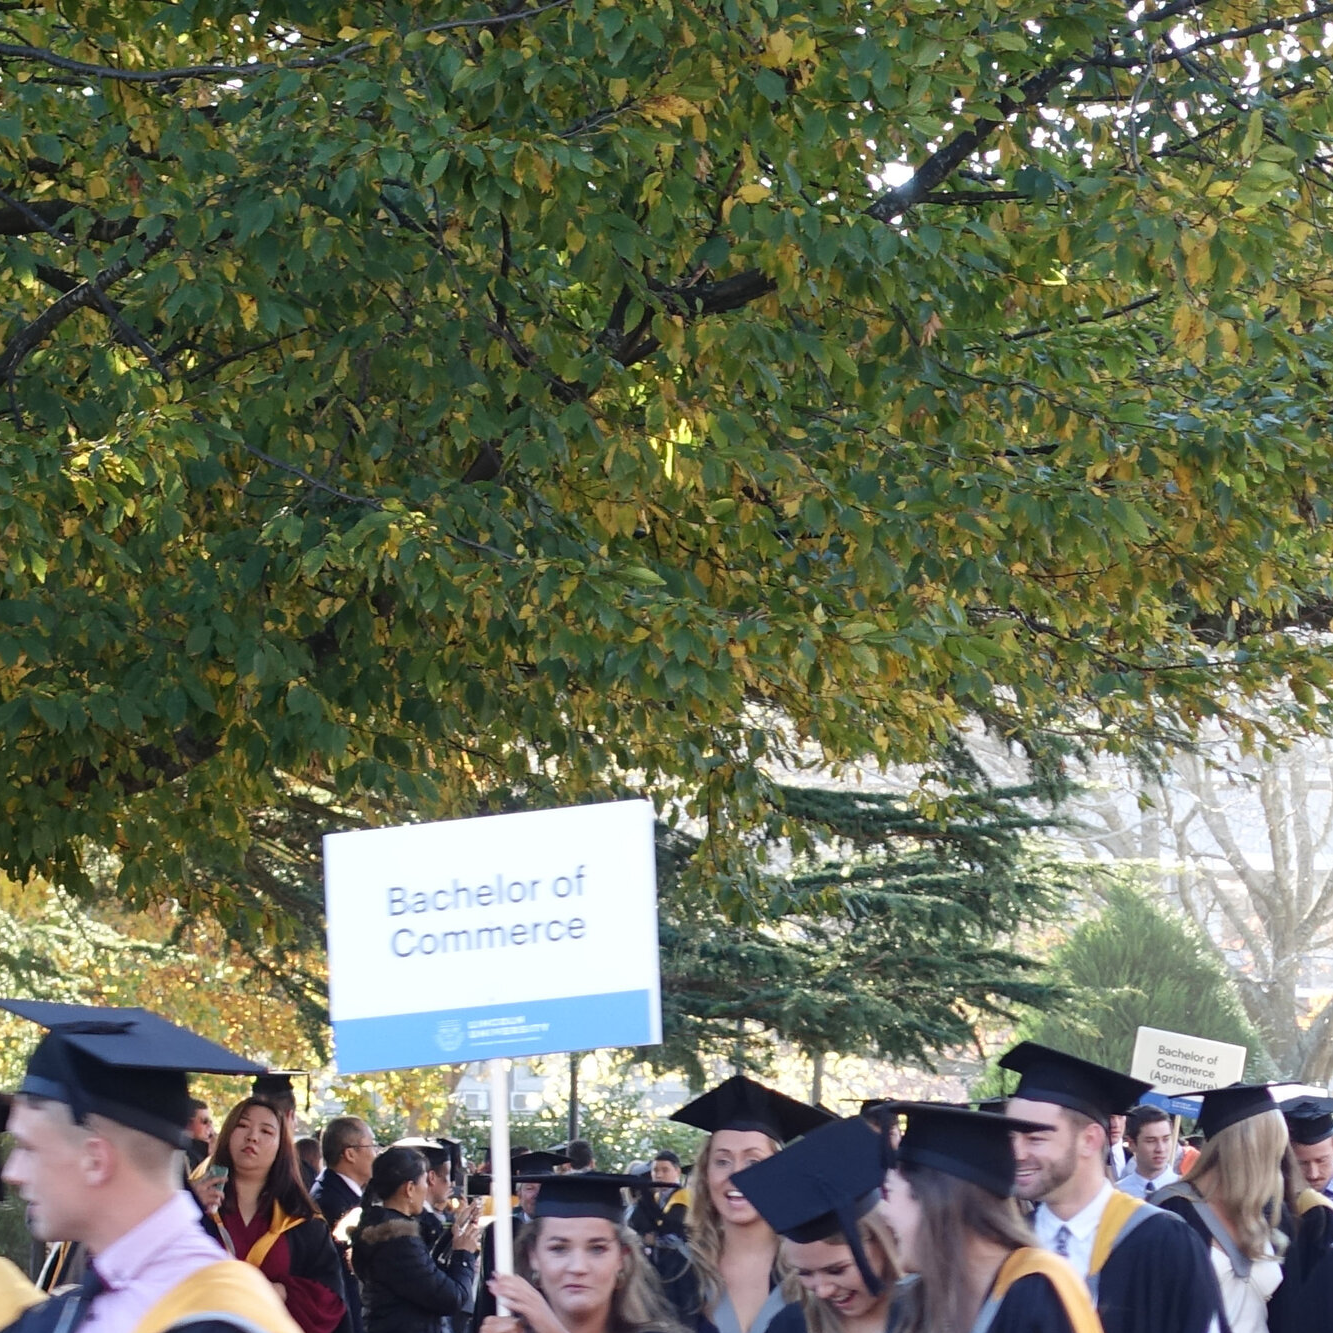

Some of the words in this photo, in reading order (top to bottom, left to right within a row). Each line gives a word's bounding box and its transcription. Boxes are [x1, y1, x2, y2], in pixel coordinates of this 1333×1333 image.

[388, 873, 541, 917] Bachelor
[552, 864, 586, 898] of
[391, 917, 586, 958] Commerce
[1156, 1057, 1216, 1079] Commerce
[1158, 1044, 1205, 1062] Bachelor
[1207, 1055, 1219, 1065] of
